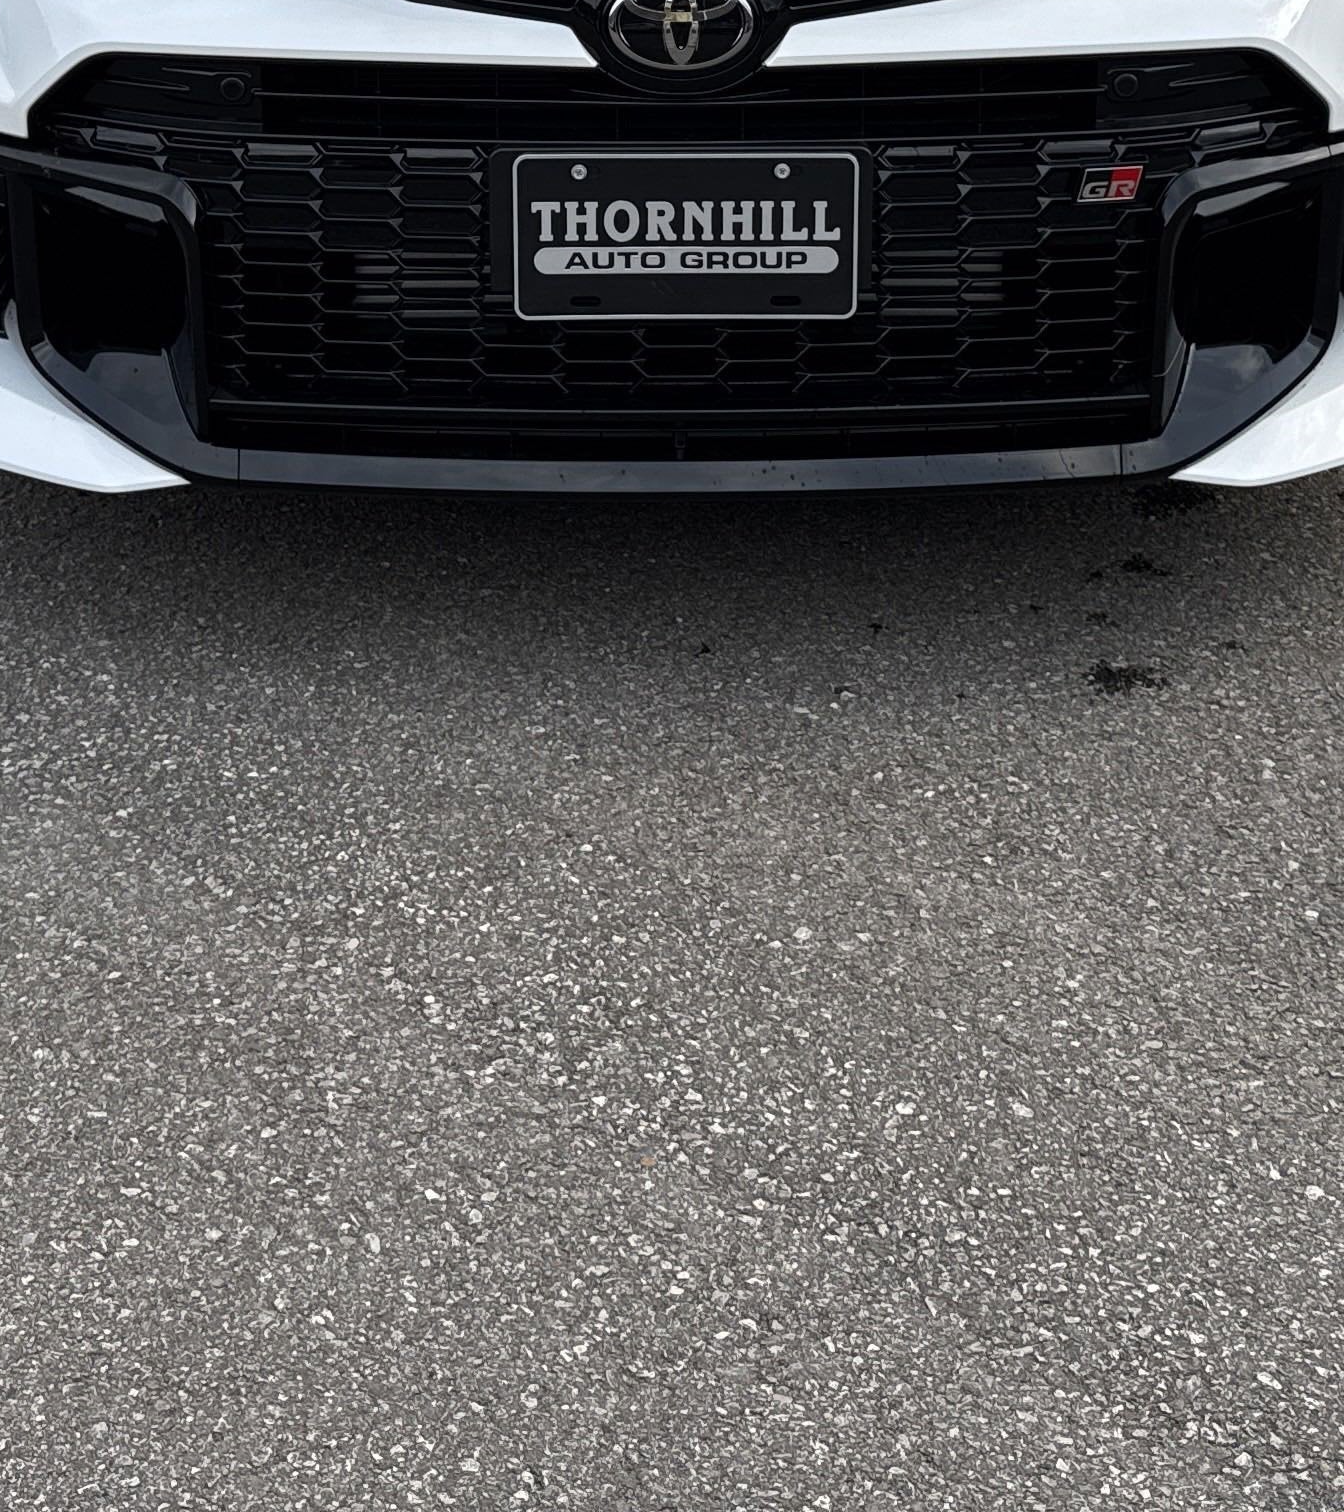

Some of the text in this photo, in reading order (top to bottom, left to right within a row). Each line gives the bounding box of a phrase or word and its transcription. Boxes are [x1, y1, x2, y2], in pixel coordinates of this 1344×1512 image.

[1082, 179, 1136, 198] GR
[530, 200, 841, 242] THORNHILL
[564, 251, 808, 270] AUTO GROUP
